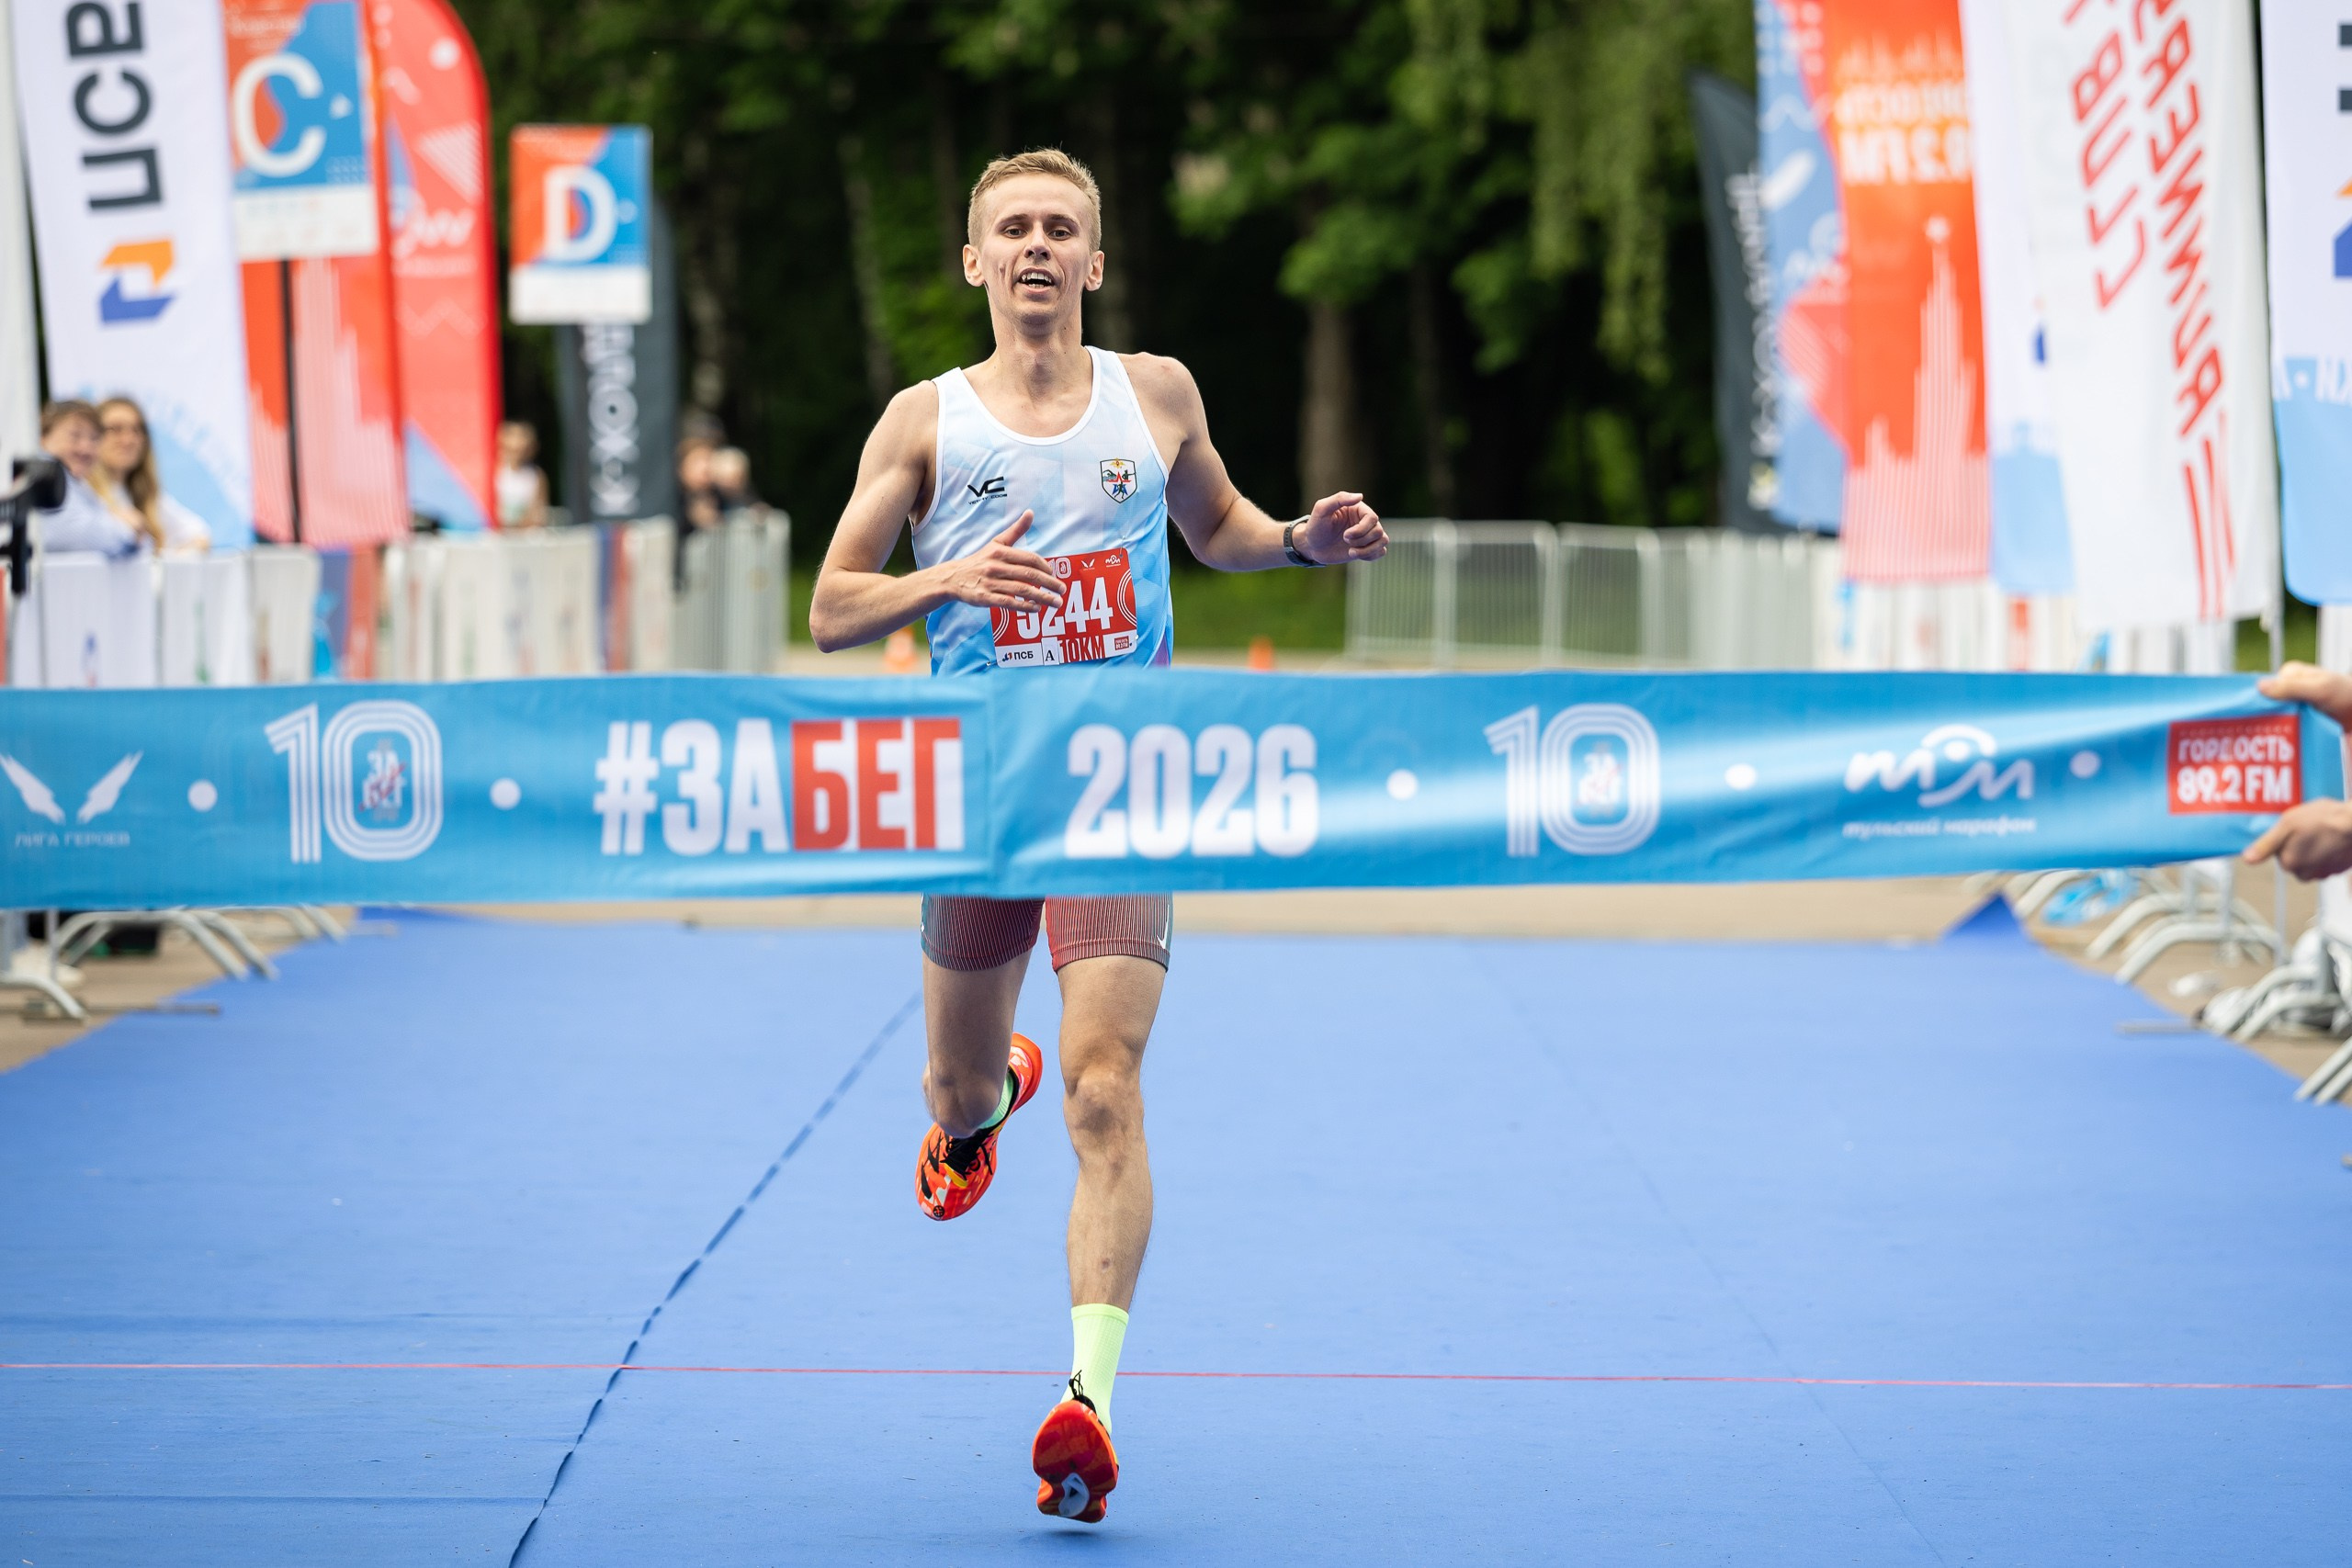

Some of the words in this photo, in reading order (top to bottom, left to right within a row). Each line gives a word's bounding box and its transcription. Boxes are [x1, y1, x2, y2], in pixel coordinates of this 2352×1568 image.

[544, 166, 617, 262] D
[1014, 650, 1034, 660] ПСБ
[264, 700, 444, 863] 10
[594, 718, 964, 855] #ЗАБЕГ
[1064, 724, 1318, 859] 2026
[1483, 704, 1661, 858] 10
[2177, 765, 2242, 805] 89.2
[2245, 765, 2293, 804] FM
[2178, 736, 2294, 763] ГОРДОСТЬ
